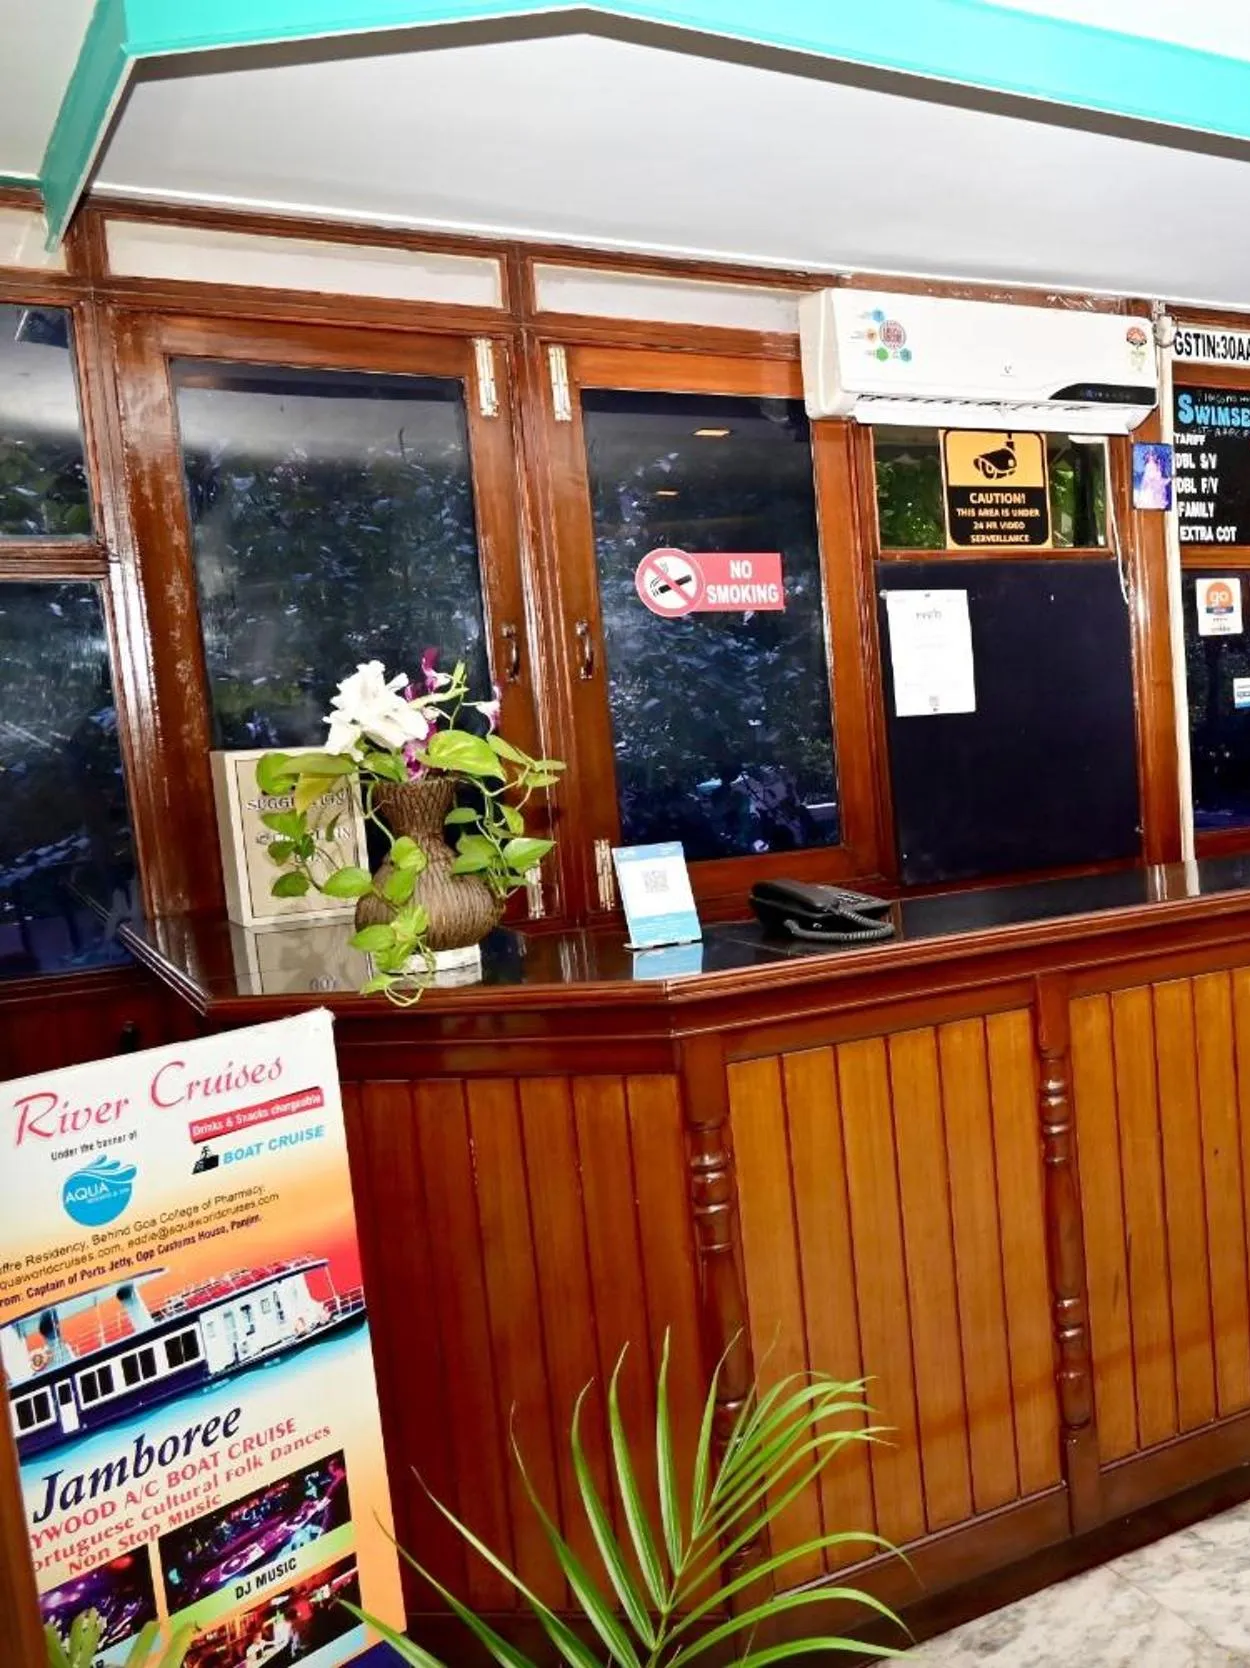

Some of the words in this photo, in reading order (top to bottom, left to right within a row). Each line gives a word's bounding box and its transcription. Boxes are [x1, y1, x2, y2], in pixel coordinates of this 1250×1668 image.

[1174, 453, 1196, 469] DBL
[969, 492, 1026, 504] CAUTION!
[1176, 477, 1197, 494] DBL
[956, 508, 976, 517] THIS
[977, 508, 1000, 517] AREA
[1001, 508, 1010, 517] IS
[1011, 508, 1041, 517] UNDER
[1178, 501, 1215, 518] FAMILY
[973, 521, 984, 530] 24
[1000, 521, 1026, 530] VIDEO
[1180, 526, 1214, 542] EXTRA
[1216, 526, 1238, 542] COT
[729, 559, 753, 580] NO
[706, 583, 780, 605] SMOKING
[13, 1091, 130, 1147] River
[150, 1056, 284, 1108] Cruises
[191, 1120, 225, 1138] Drinks
[235, 1106, 270, 1125] Snacks
[50, 1147, 78, 1161] Under
[79, 1143, 94, 1154] the
[95, 1135, 127, 1149] banner
[222, 1142, 264, 1165] BOAT
[268, 1125, 326, 1153] CRUISE
[65, 1181, 110, 1204] AQUA
[91, 1226, 131, 1246] Behind
[133, 1218, 158, 1232] Goa
[160, 1204, 200, 1224] College
[201, 1199, 212, 1211] of
[26, 1278, 67, 1299] Captain
[67, 1272, 78, 1285] of
[79, 1264, 107, 1282] Ports
[135, 1247, 156, 1262] Opp
[157, 1234, 197, 1256] Customs
[270, 1425, 332, 1462] Dances
[32, 1406, 242, 1524] Jamboree
[124, 1479, 160, 1510] A/C
[165, 1450, 221, 1489] BOAT
[227, 1416, 297, 1461] CRUISE
[68, 1547, 111, 1575] Non
[118, 1522, 162, 1548] Stop
[167, 1494, 222, 1528] Music
[234, 1581, 252, 1600] DJ
[255, 1557, 297, 1589] MUSIC
